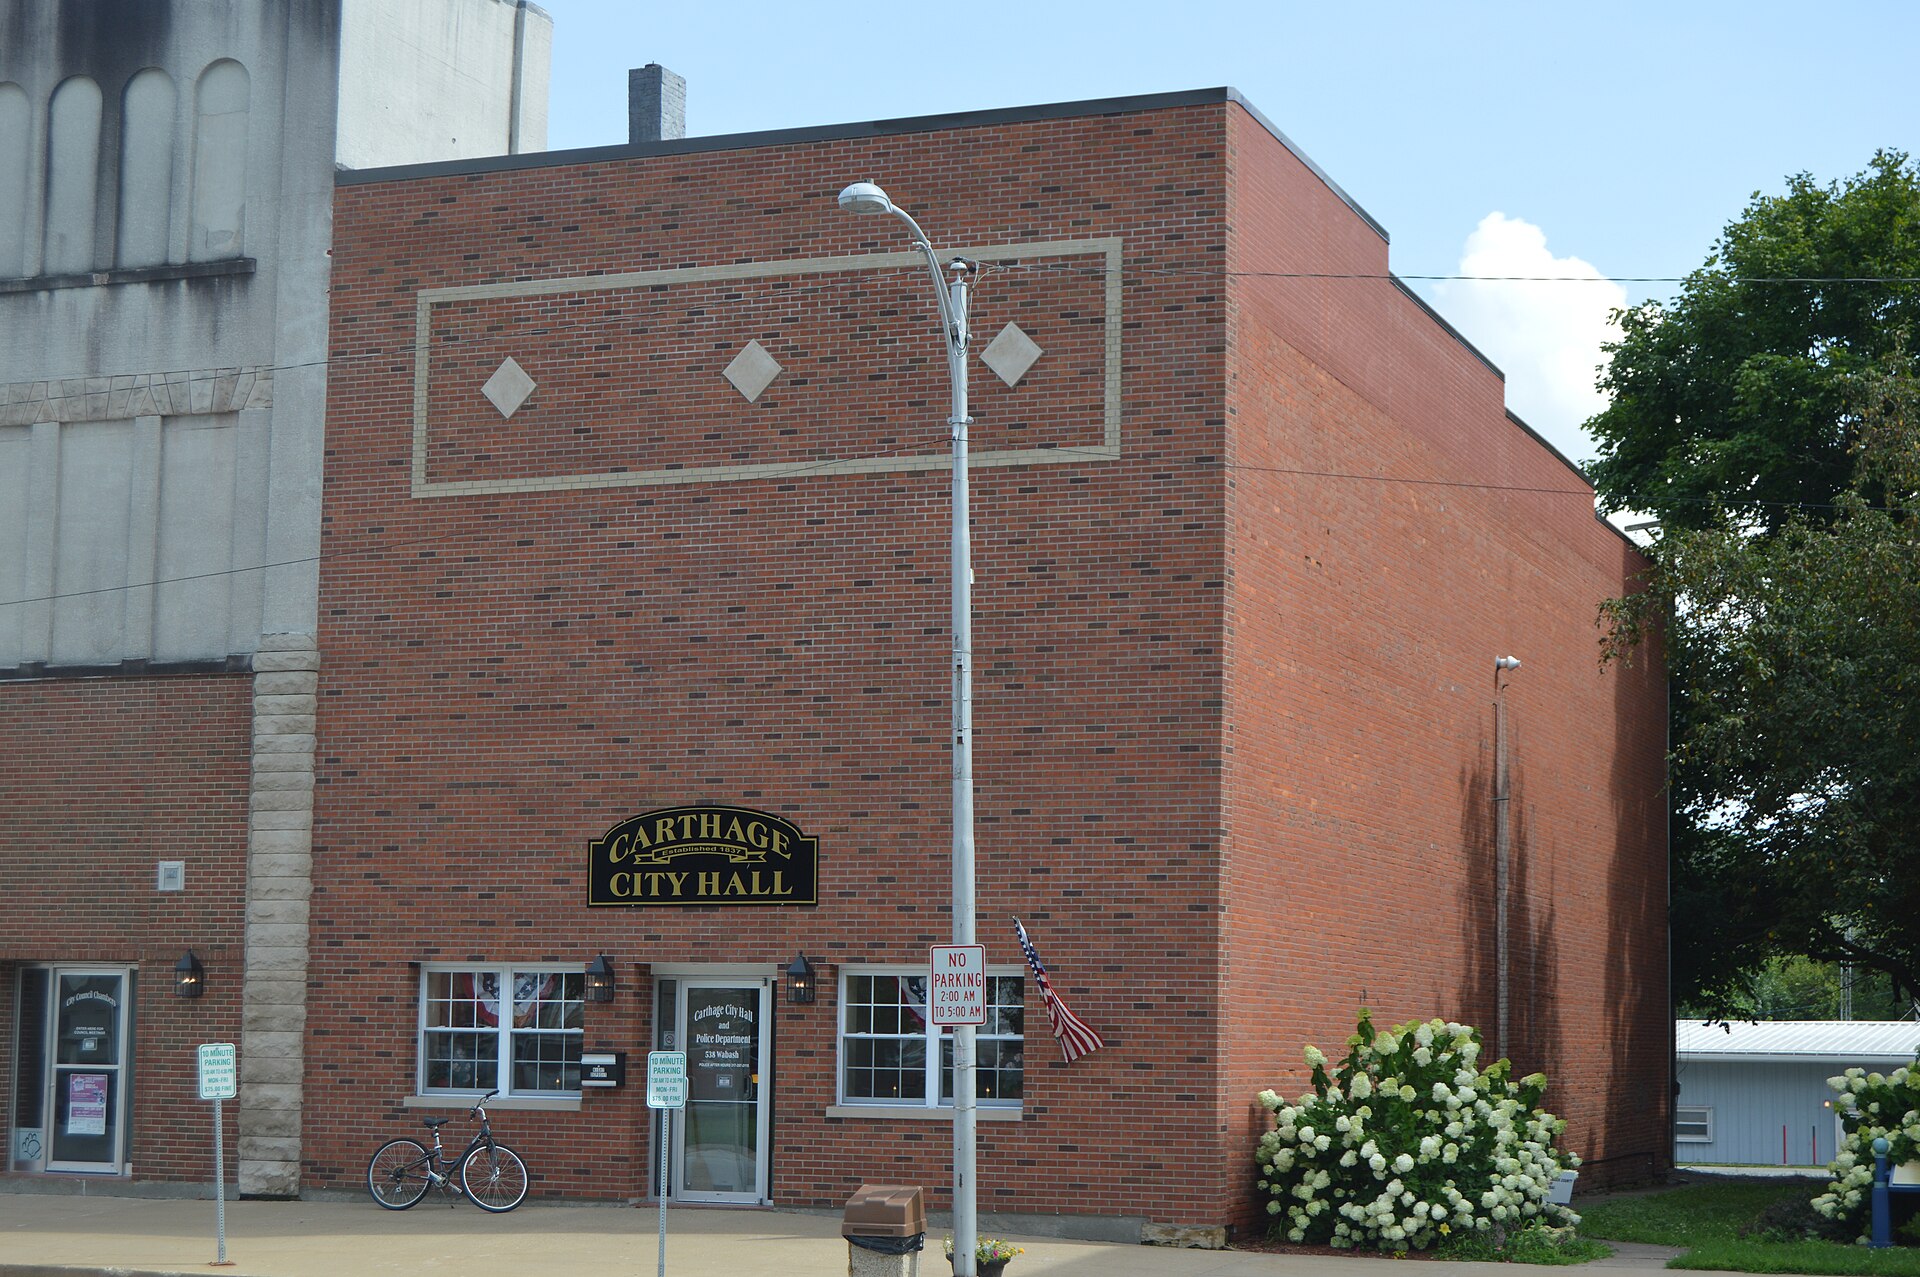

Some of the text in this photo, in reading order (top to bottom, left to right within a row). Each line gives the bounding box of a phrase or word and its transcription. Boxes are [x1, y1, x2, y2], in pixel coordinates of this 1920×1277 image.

[609, 813, 792, 864] CARTHAGE
[662, 845, 742, 857] Established 1837
[609, 870, 793, 897] CITY HALL
[948, 952, 966, 967] NO
[934, 972, 982, 988] PARKING
[66, 990, 116, 1007] City Council Chambers
[941, 990, 975, 1002] 2:00 AM
[694, 1003, 753, 1023] Carthage City Hall
[935, 1006, 981, 1017] TO 5:00 AM
[718, 1021, 730, 1029] and
[696, 1033, 751, 1045] Police Department
[210, 1049, 233, 1057] MINUTE
[704, 1050, 739, 1059] 538 Wabash
[204, 1058, 231, 1066] PARKING
[651, 1057, 684, 1065] 10 MINUTE
[653, 1066, 681, 1074] PARKING
